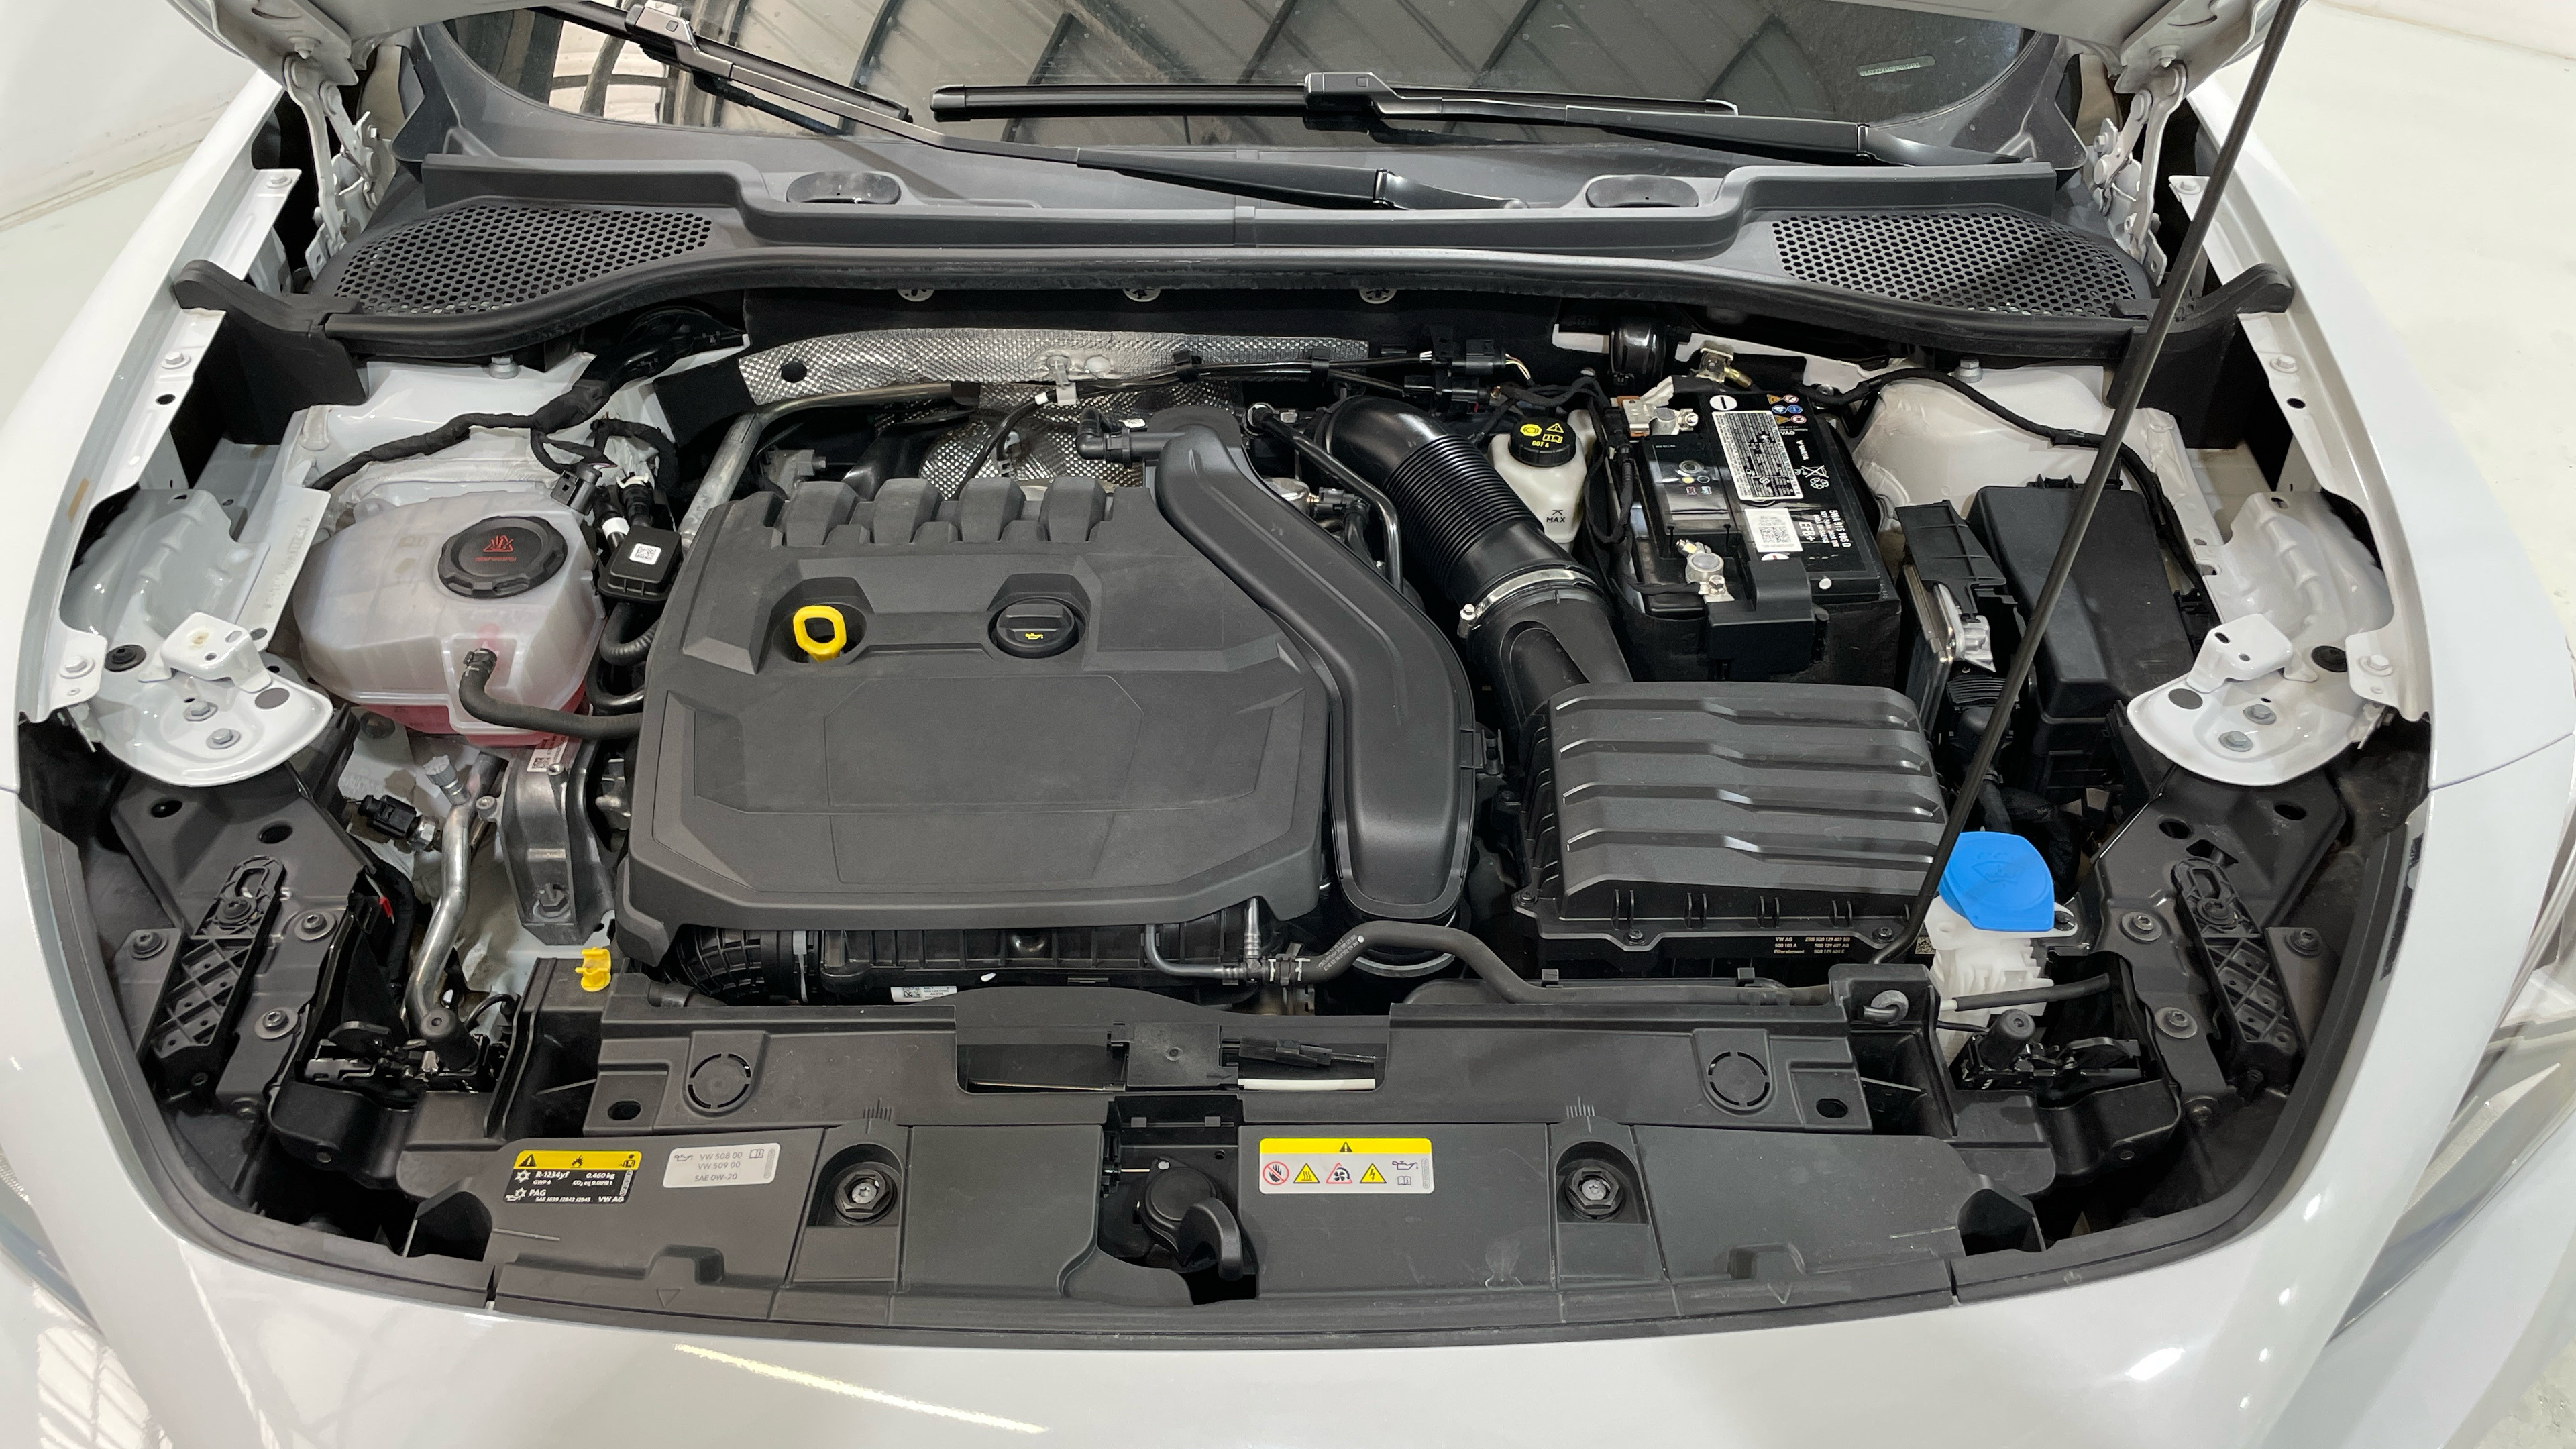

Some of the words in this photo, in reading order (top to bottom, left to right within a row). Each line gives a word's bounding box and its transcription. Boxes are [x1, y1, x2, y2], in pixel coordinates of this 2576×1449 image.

[1799, 521, 1815, 541] EFB+
[535, 1171, 570, 1181] R-1234yf
[528, 1189, 547, 1197] PAG
